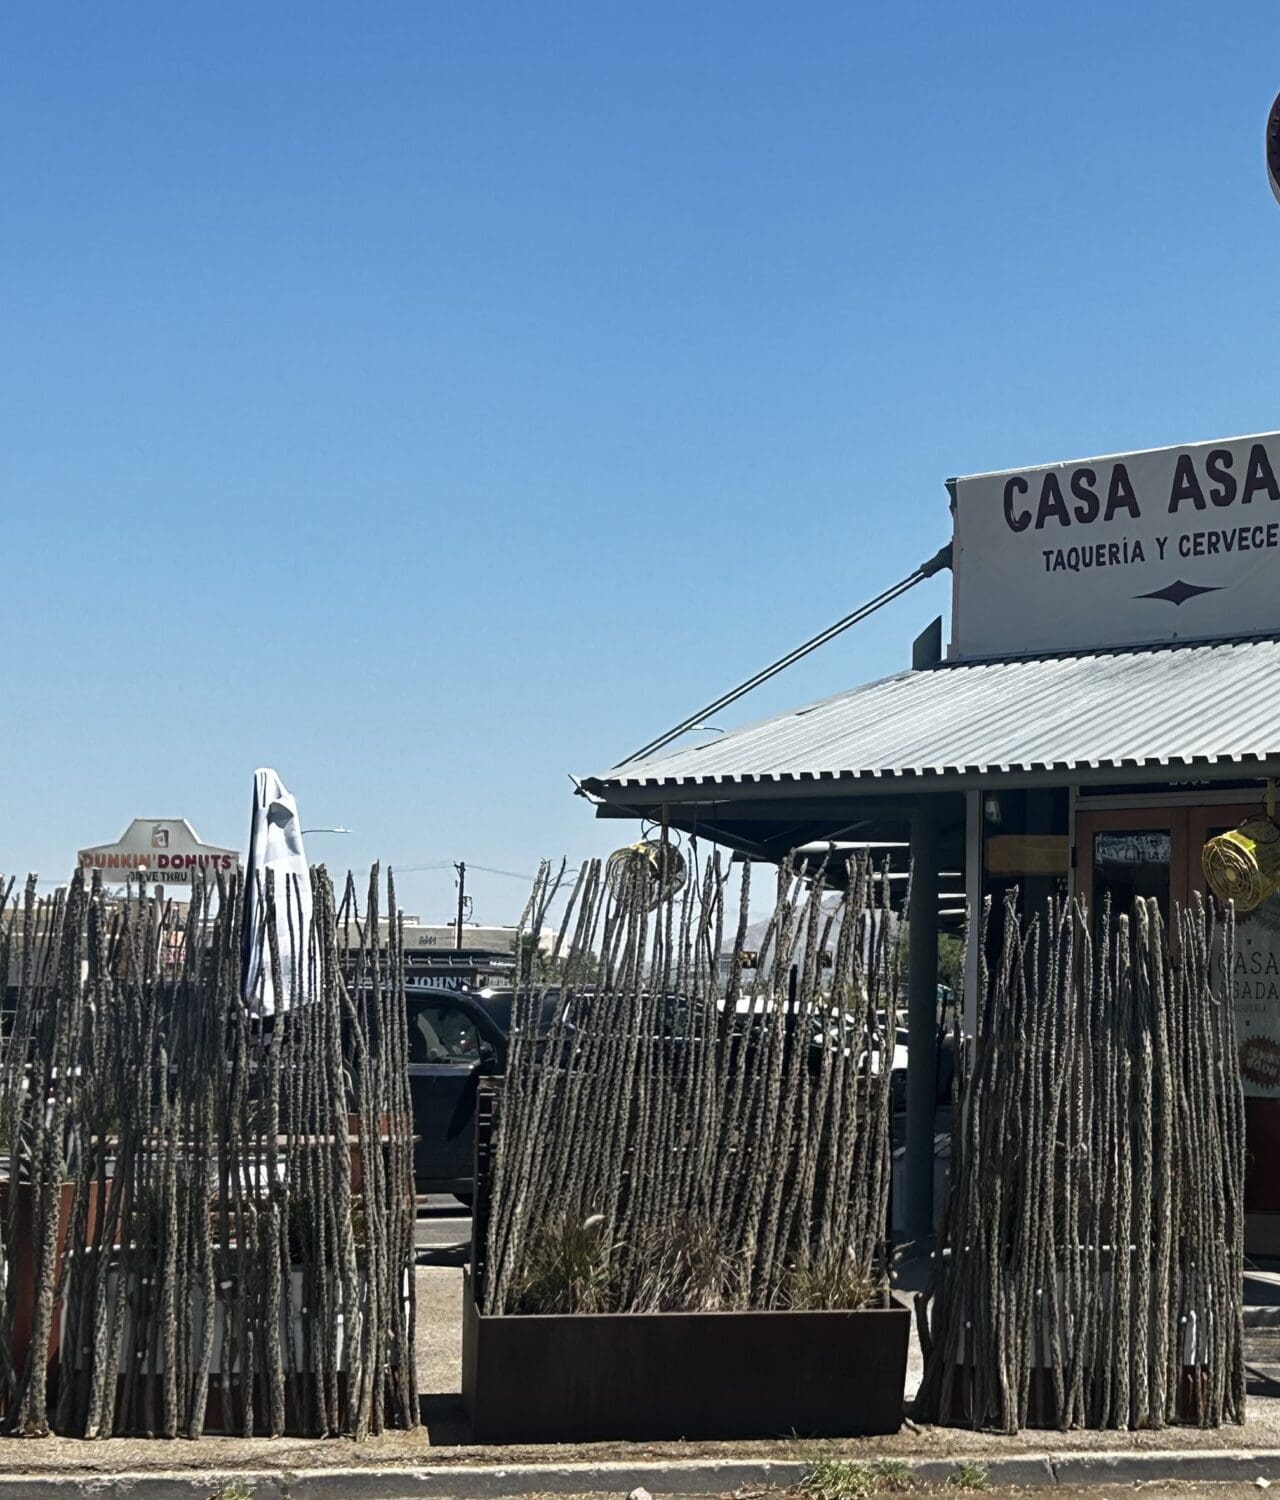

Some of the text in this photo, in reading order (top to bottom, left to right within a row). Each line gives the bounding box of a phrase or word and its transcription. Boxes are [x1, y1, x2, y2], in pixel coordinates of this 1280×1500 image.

[1003, 463, 1142, 533] CASA
[1042, 536, 1146, 573] TAQUERÍA
[1156, 536, 1169, 561] Y
[160, 871, 187, 882] THRU
